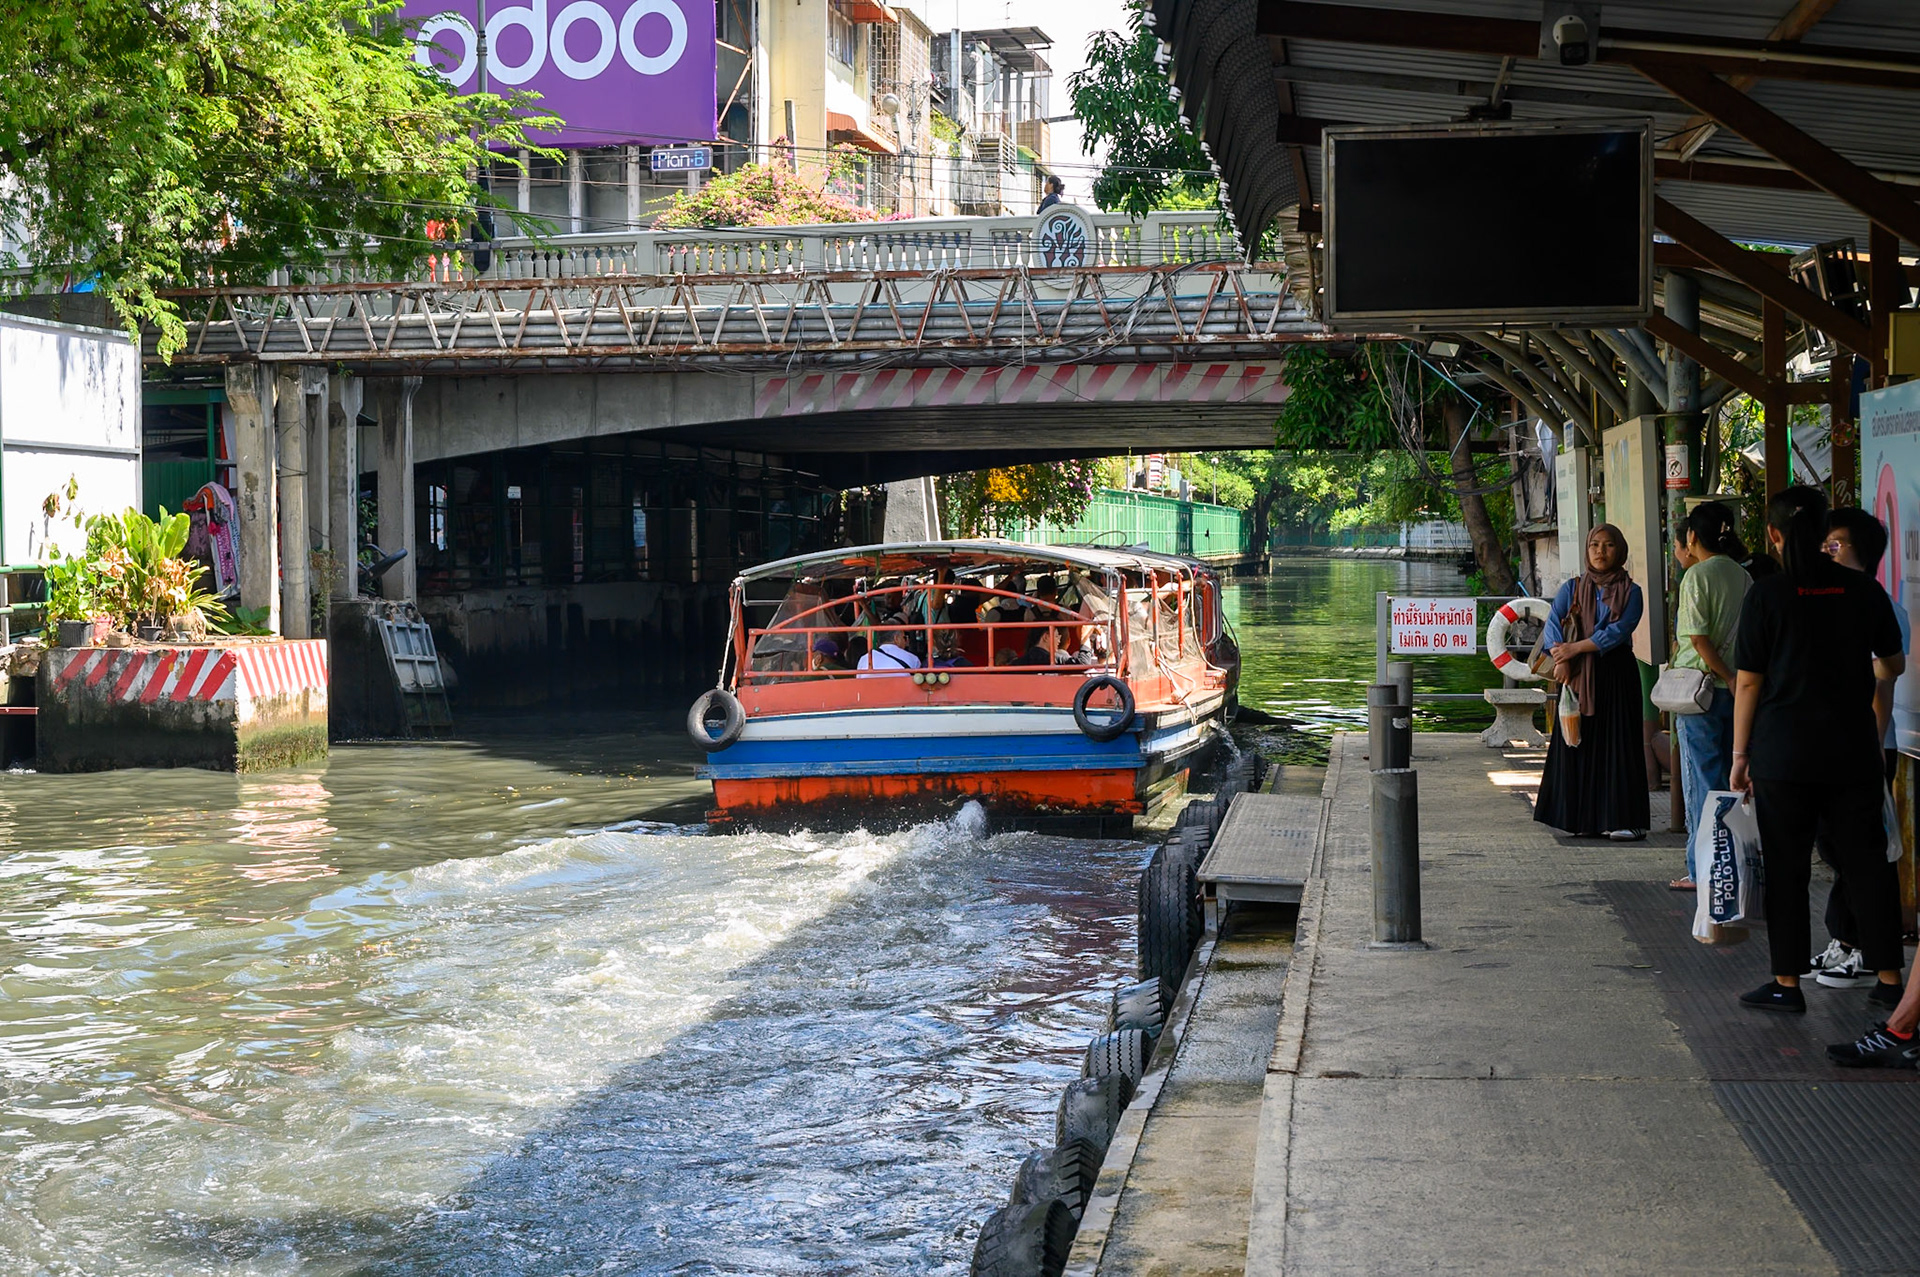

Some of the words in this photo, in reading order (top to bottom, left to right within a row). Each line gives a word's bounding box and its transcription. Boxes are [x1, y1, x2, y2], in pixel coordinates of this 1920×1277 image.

[415, 0, 688, 88] odoo
[1393, 603, 1473, 625] ท่านี้รับน้ำหนักได้
[1399, 630, 1428, 647] ไม่เกิน
[1433, 633, 1447, 648] 60
[1452, 634, 1467, 647] คน
[1719, 828, 1732, 863] CLUB
[1723, 866, 1735, 900] POLO
